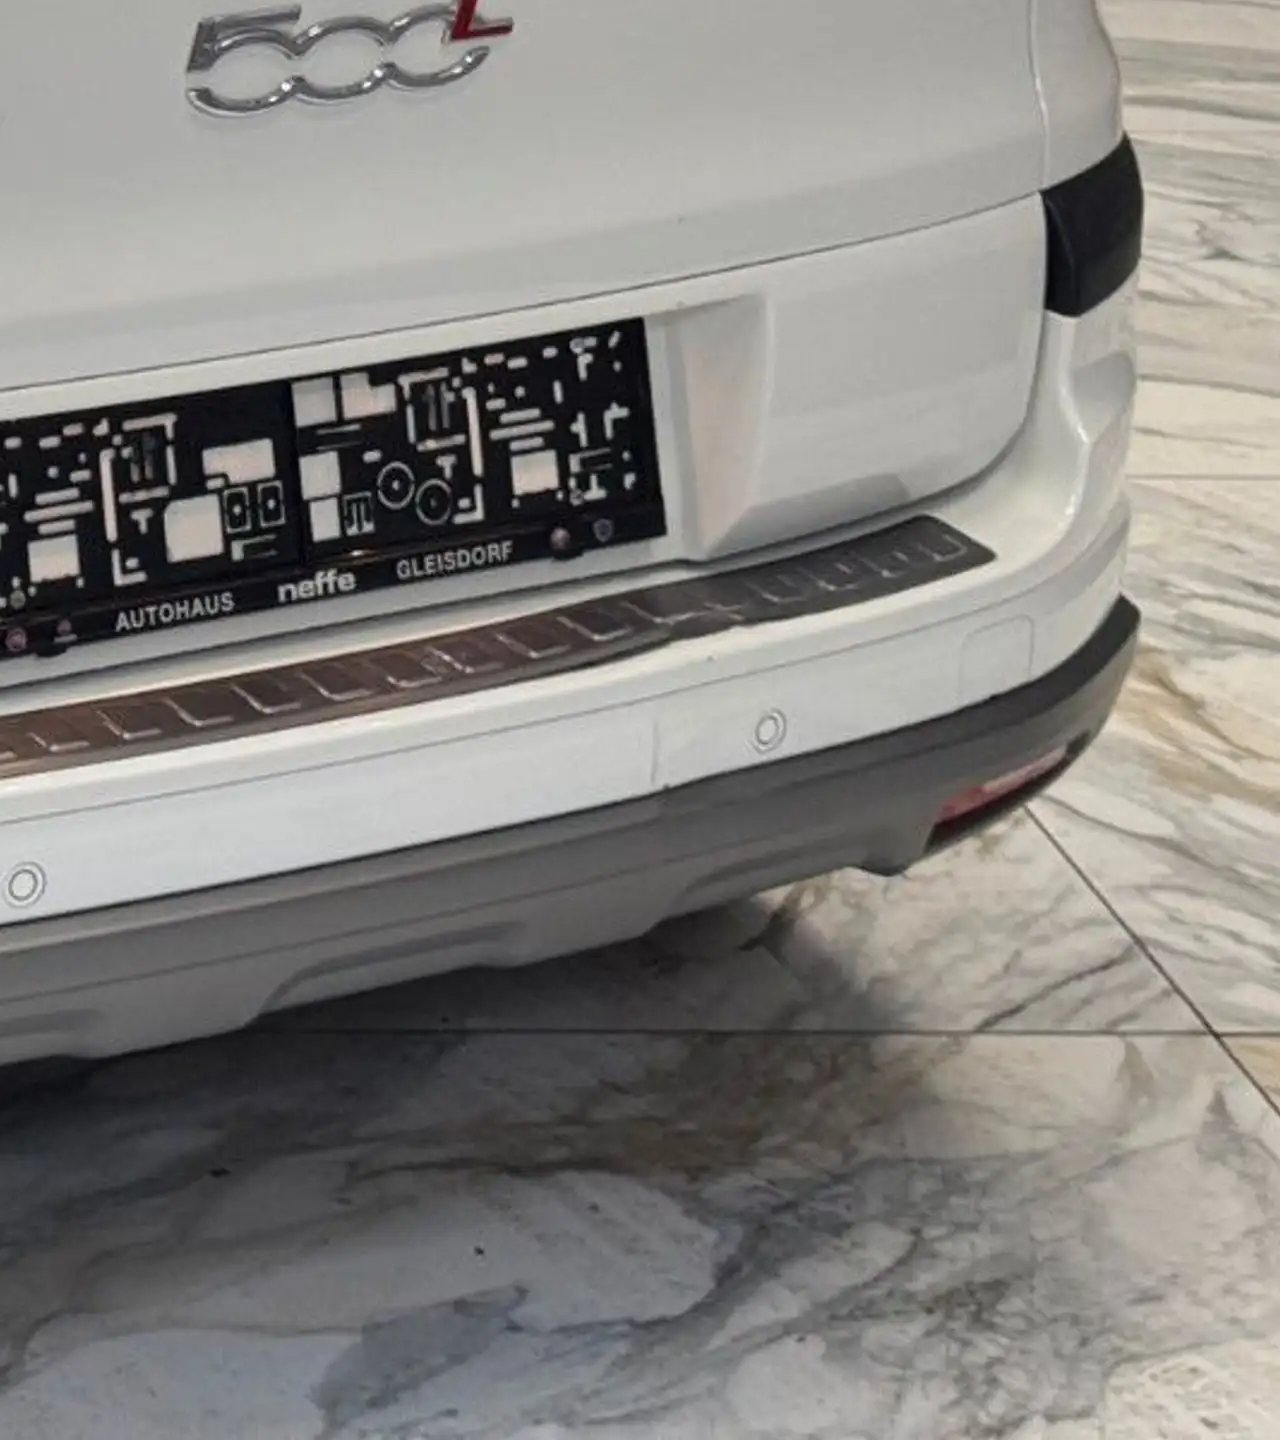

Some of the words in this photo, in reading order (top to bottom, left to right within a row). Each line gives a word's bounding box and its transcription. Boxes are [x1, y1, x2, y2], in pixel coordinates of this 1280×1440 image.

[114, 591, 236, 633] AUTOHAUS
[276, 568, 357, 603] neffe
[395, 539, 515, 581] GLEISDORF
